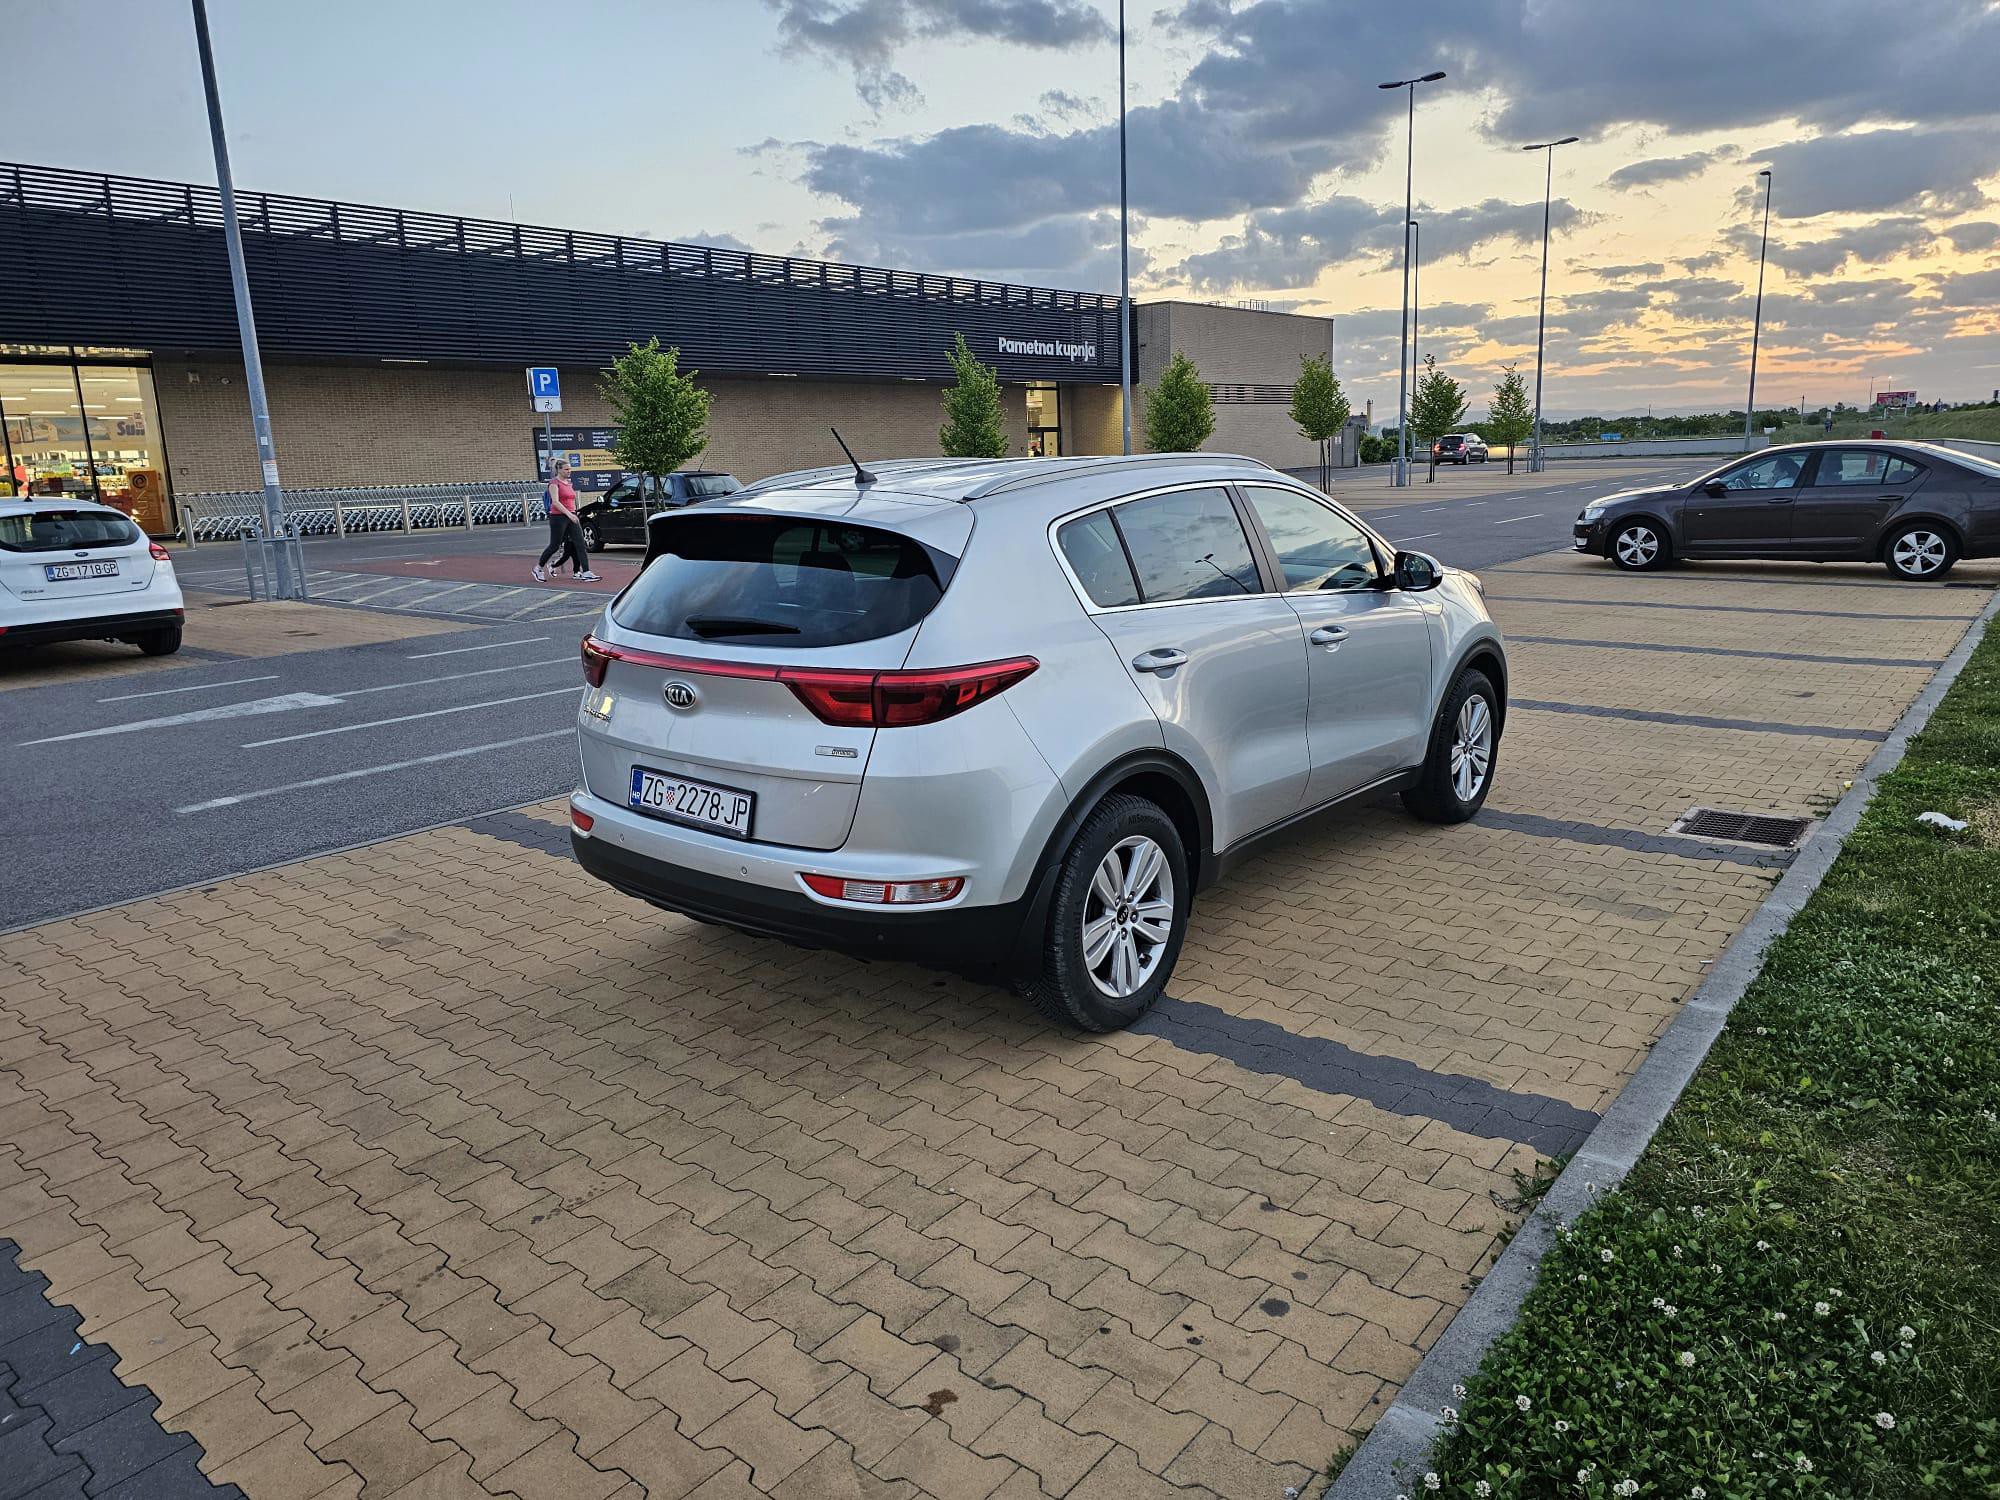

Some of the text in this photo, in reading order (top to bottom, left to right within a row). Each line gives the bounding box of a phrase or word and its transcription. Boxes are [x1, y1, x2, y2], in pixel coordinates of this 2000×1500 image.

[998, 337, 1096, 362] Pametna kupnja
[540, 374, 551, 391] P
[54, 567, 69, 578] ZG
[667, 687, 690, 705] KIA
[632, 791, 641, 799] HR
[642, 775, 665, 807] ZG
